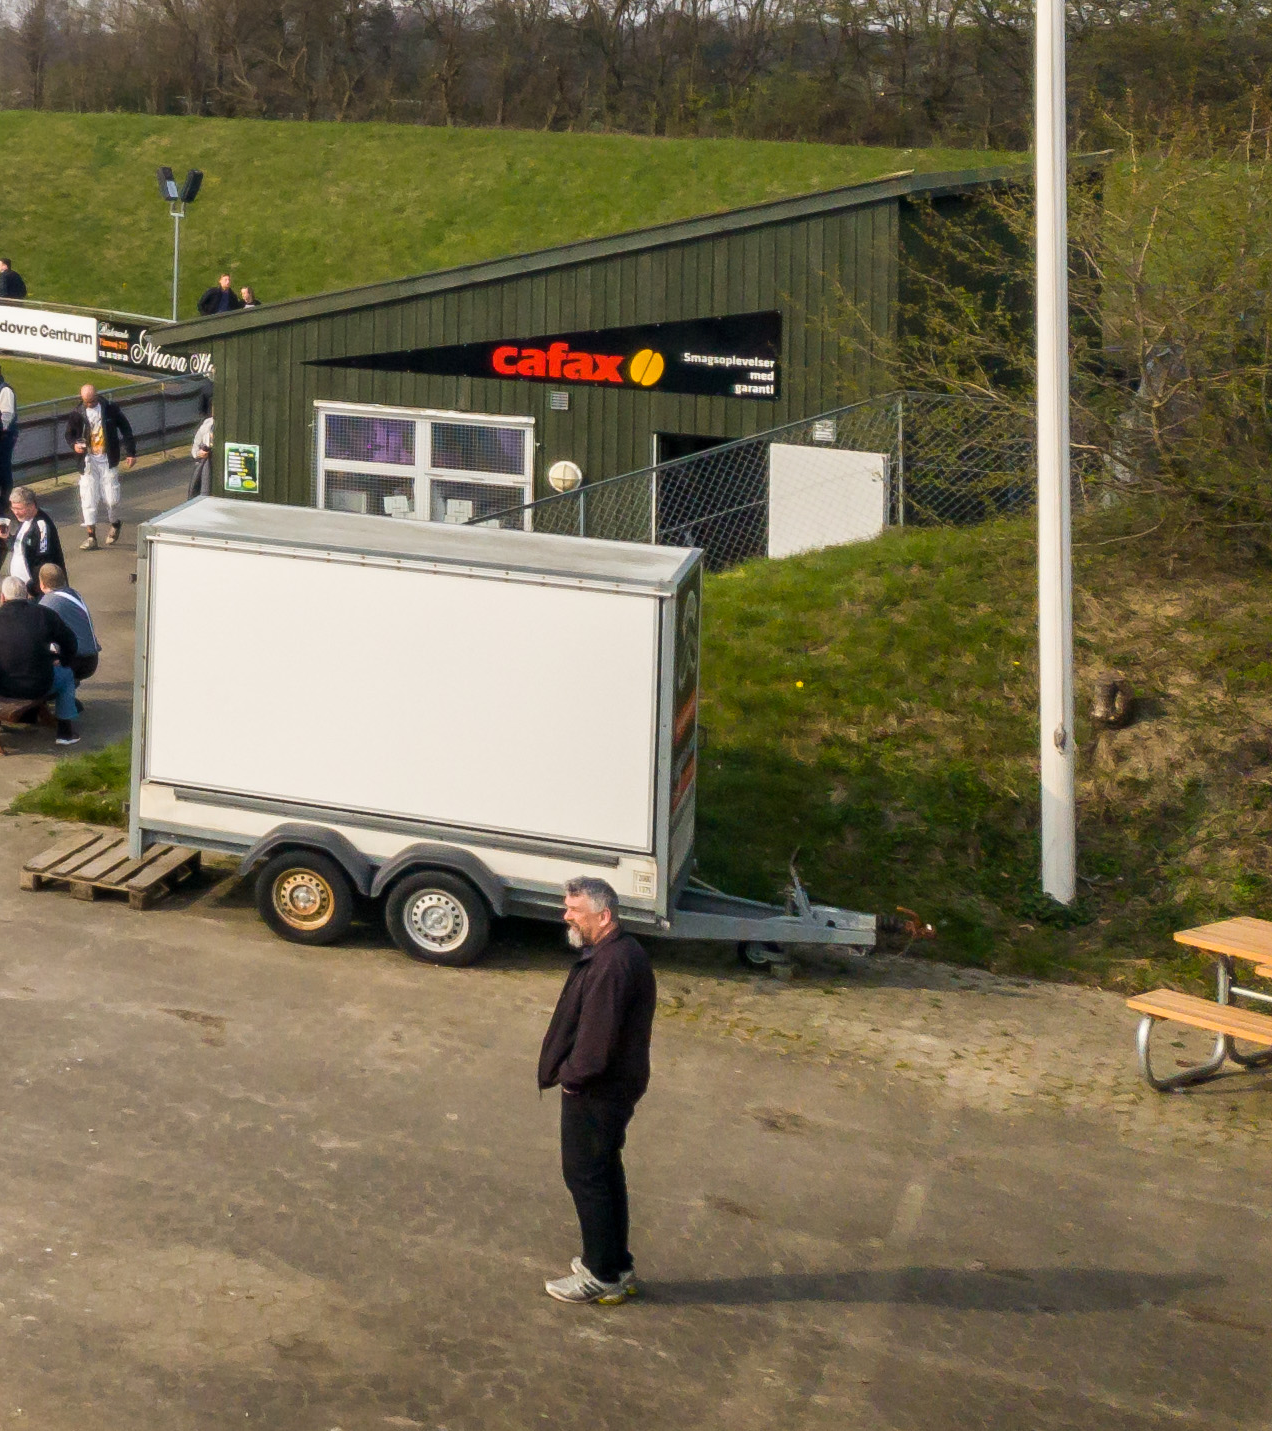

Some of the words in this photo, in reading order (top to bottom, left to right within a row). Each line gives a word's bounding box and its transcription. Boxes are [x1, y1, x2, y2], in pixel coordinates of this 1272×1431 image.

[39, 323, 93, 345] Centrum
[130, 329, 187, 373] Nuova
[683, 352, 775, 368] Smagsoplevelser
[492, 342, 624, 383] cafax
[749, 371, 774, 381] med
[734, 383, 774, 395] garanti
